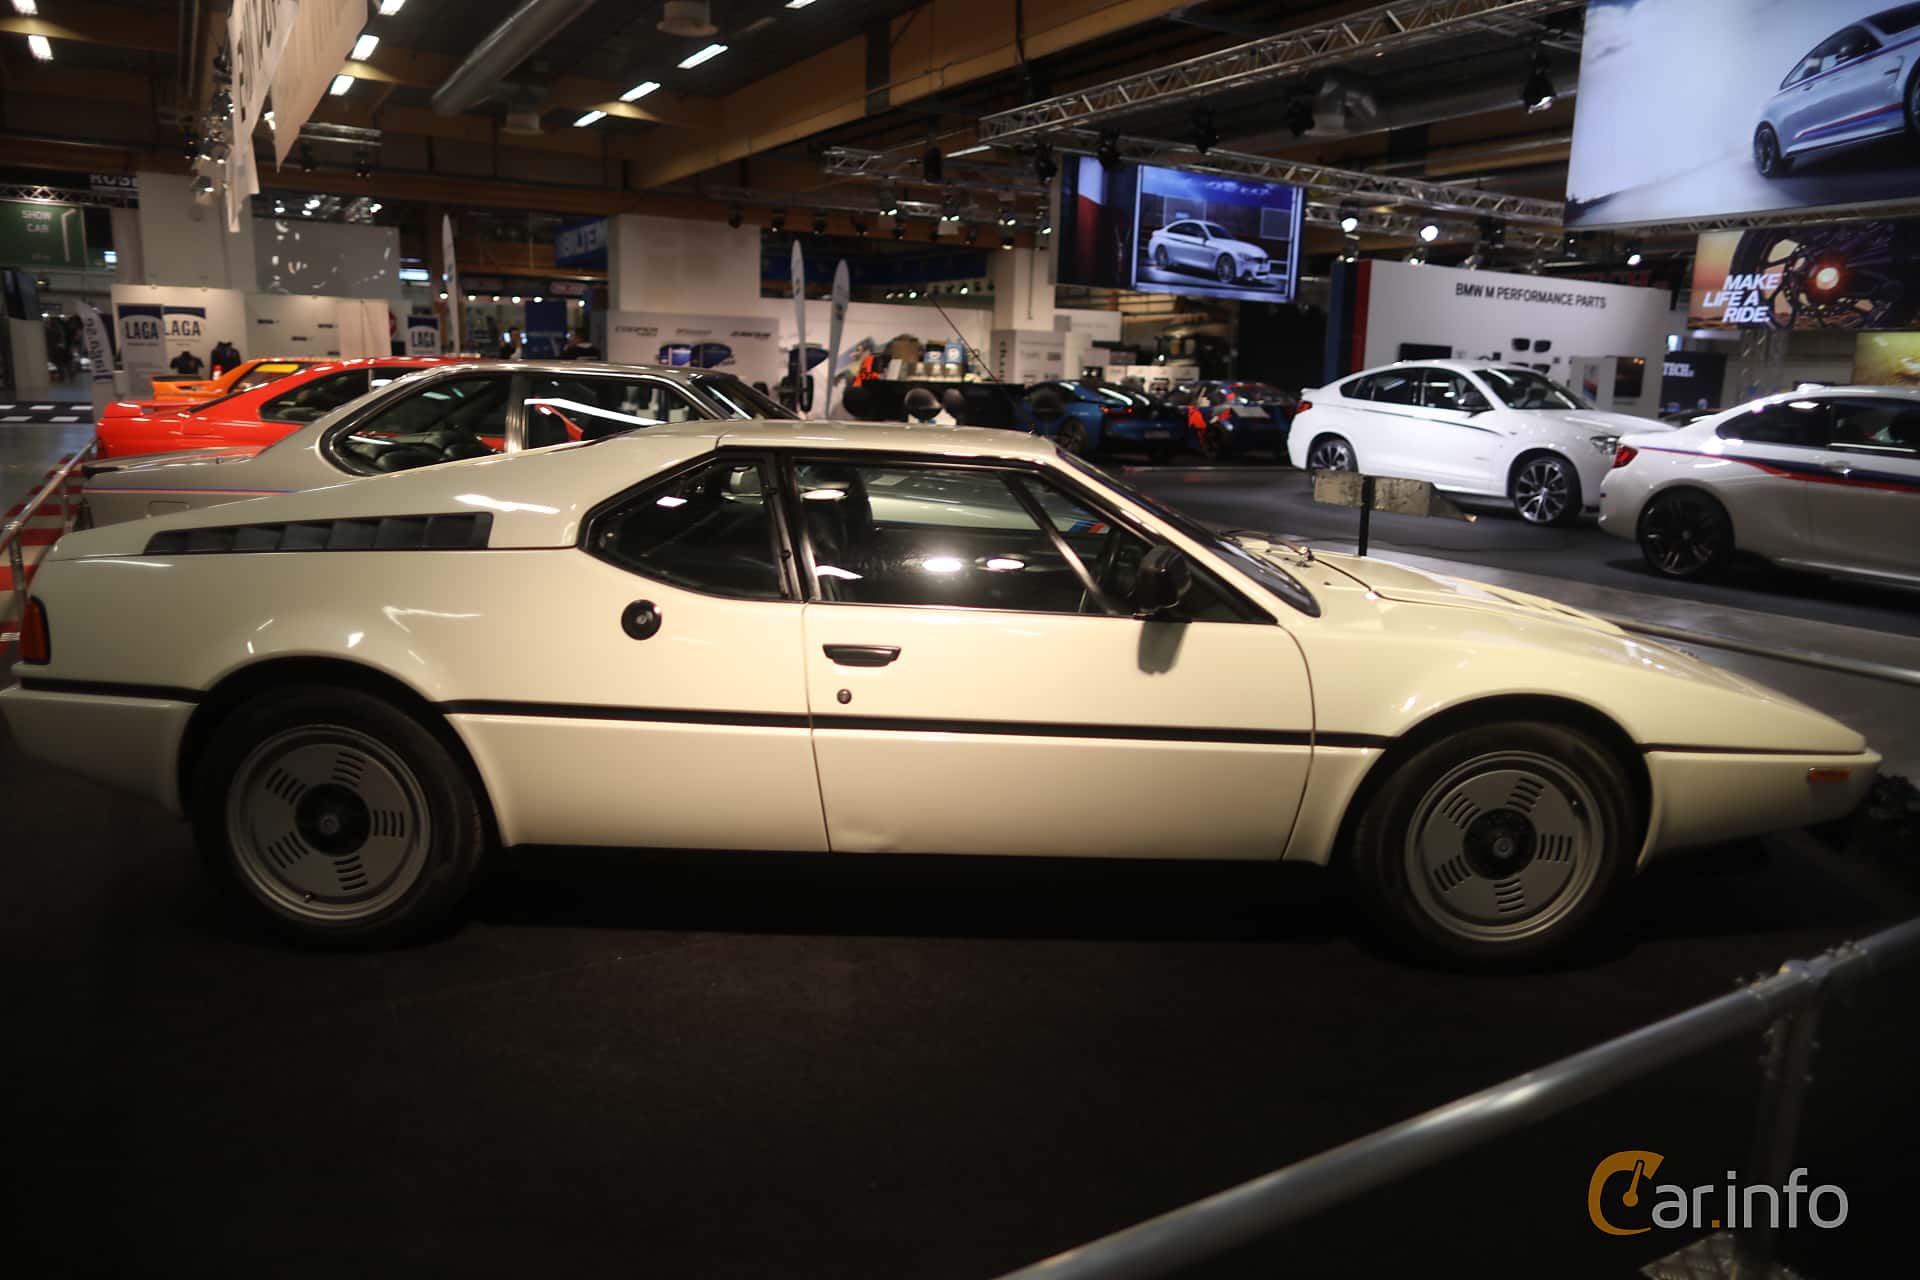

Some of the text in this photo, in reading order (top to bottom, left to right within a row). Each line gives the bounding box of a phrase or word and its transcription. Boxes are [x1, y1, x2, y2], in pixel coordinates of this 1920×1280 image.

[1723, 273, 1783, 290] MAKE
[1455, 282, 1607, 309] BMW M PERFORMANCE PARTS
[1702, 290, 1759, 307] LIFE A
[1722, 306, 1770, 323] RIDE.
[125, 321, 159, 339] LAGA
[411, 331, 435, 348] LAGA
